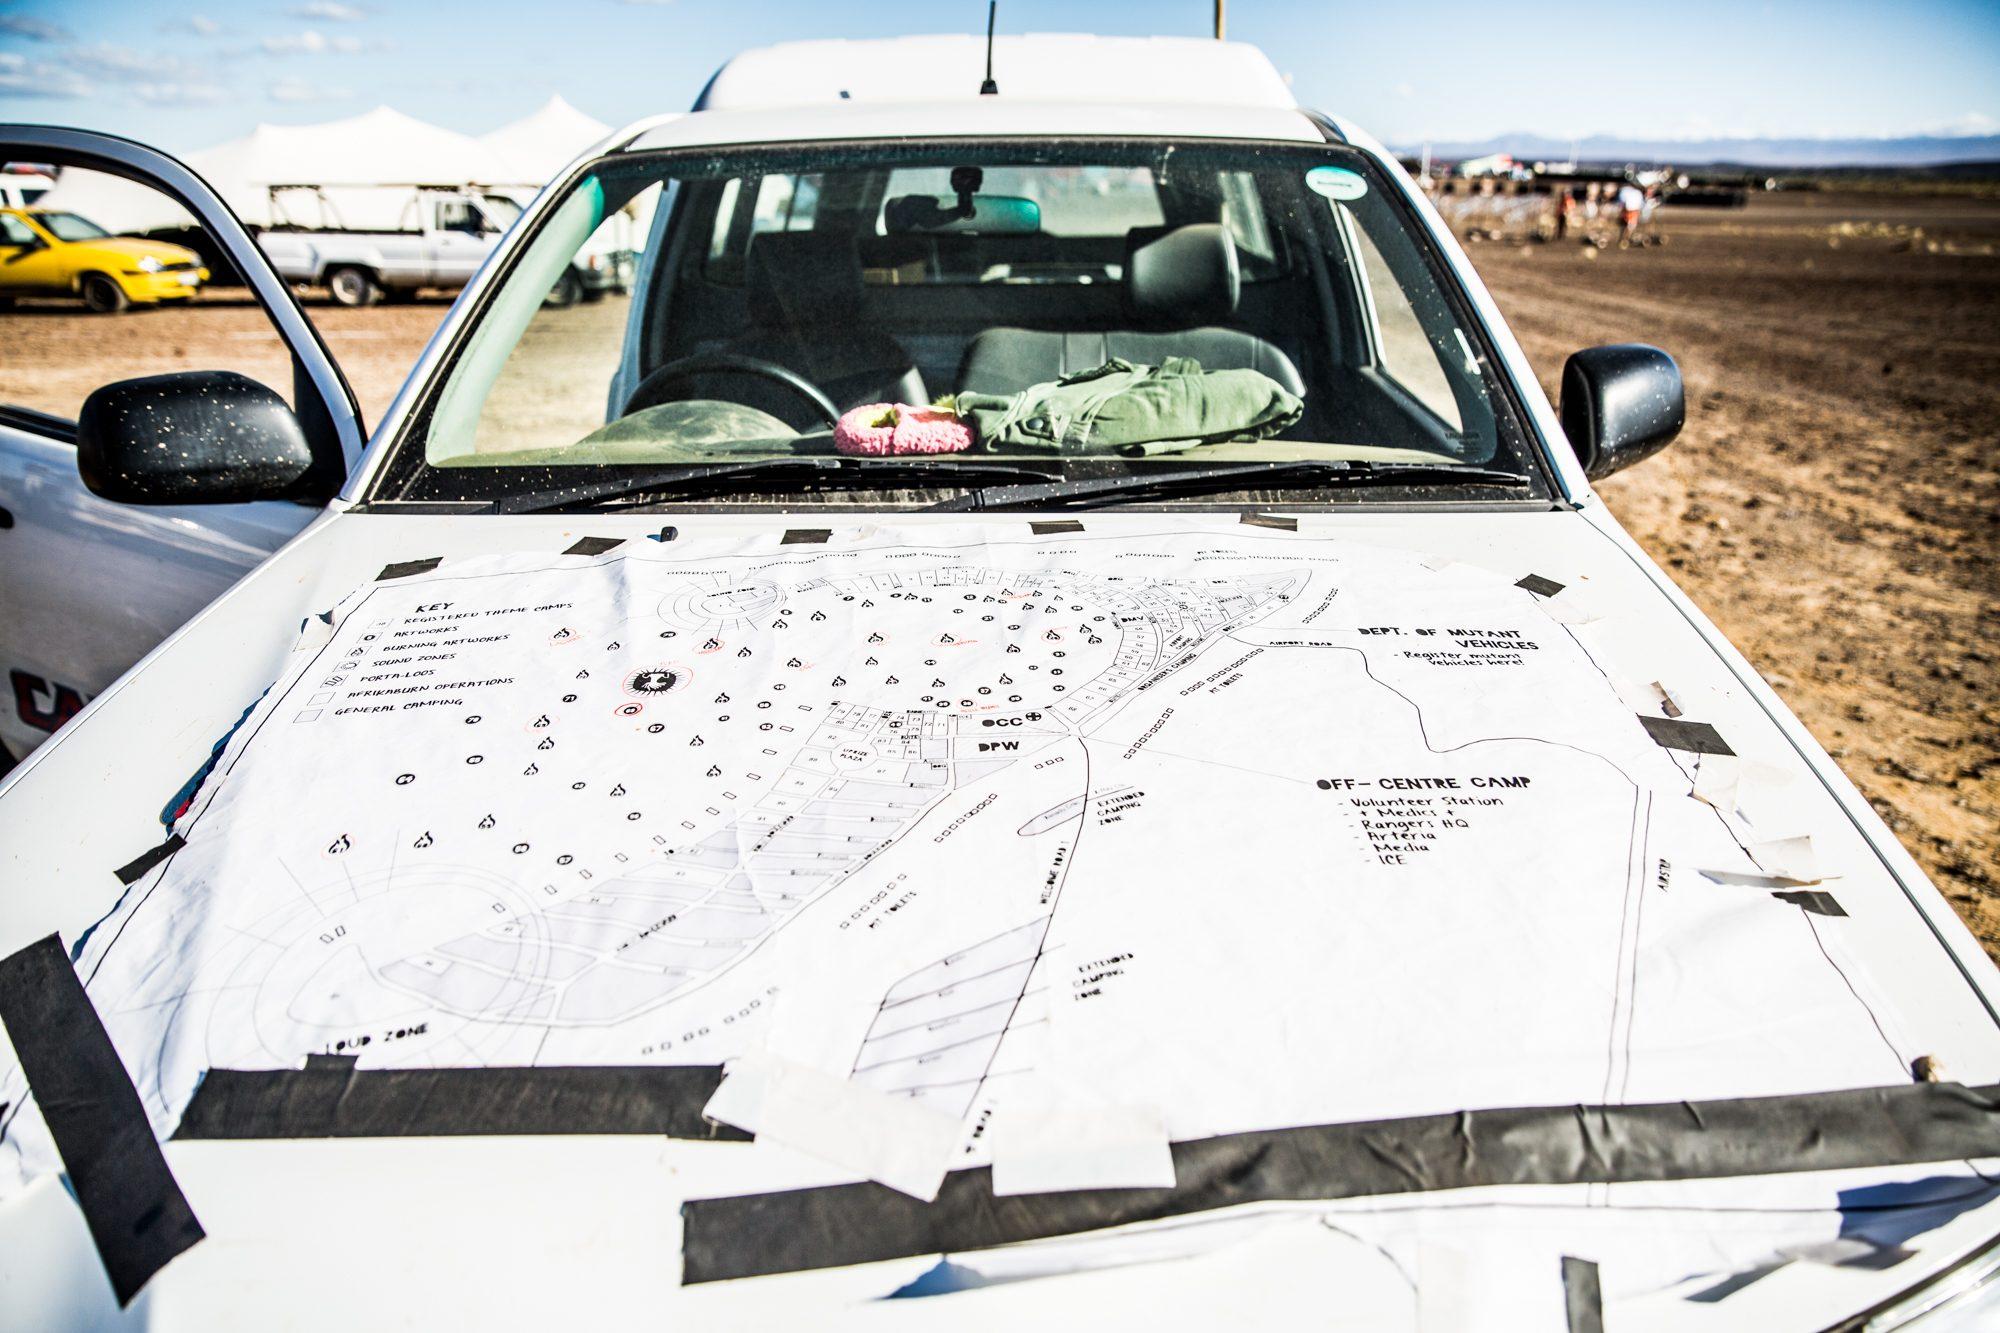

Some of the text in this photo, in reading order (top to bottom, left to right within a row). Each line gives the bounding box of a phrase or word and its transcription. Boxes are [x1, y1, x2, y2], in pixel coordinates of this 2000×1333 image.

[404, 602, 574, 625] REGISTERED THEME CAMPS
[415, 602, 455, 613] KEY
[393, 625, 461, 638] ARTWORKS
[1357, 627, 1522, 639] DEPT. OF MUTANT
[382, 633, 511, 652] BURNING ARTWORKS
[1454, 639, 1540, 650] VEHICLES
[371, 652, 458, 668] SOUND ZONES
[1403, 651, 1521, 661] Register mutant
[1428, 658, 1525, 666] vehicles here!
[359, 669, 436, 683] PORTA-LOOS
[346, 677, 515, 699] AFRIKABURN OPERATIONS
[334, 698, 464, 716] GENERAL CAMPING
[982, 717, 1024, 728] OCC
[978, 741, 1020, 752] DPW
[840, 753, 863, 762] PLAZA
[1378, 777, 1461, 790] CENTRE
[1470, 776, 1531, 789] CAMP
[1350, 796, 1504, 808] Volunteer Station
[1097, 801, 1141, 817] CAMPING
[1376, 808, 1437, 818] Medics
[1361, 818, 1470, 832] Rangers HQ
[1366, 831, 1437, 841] Arteria
[1373, 842, 1430, 852] Media
[1378, 854, 1408, 866] ICE
[383, 1022, 428, 1042] ZONE
